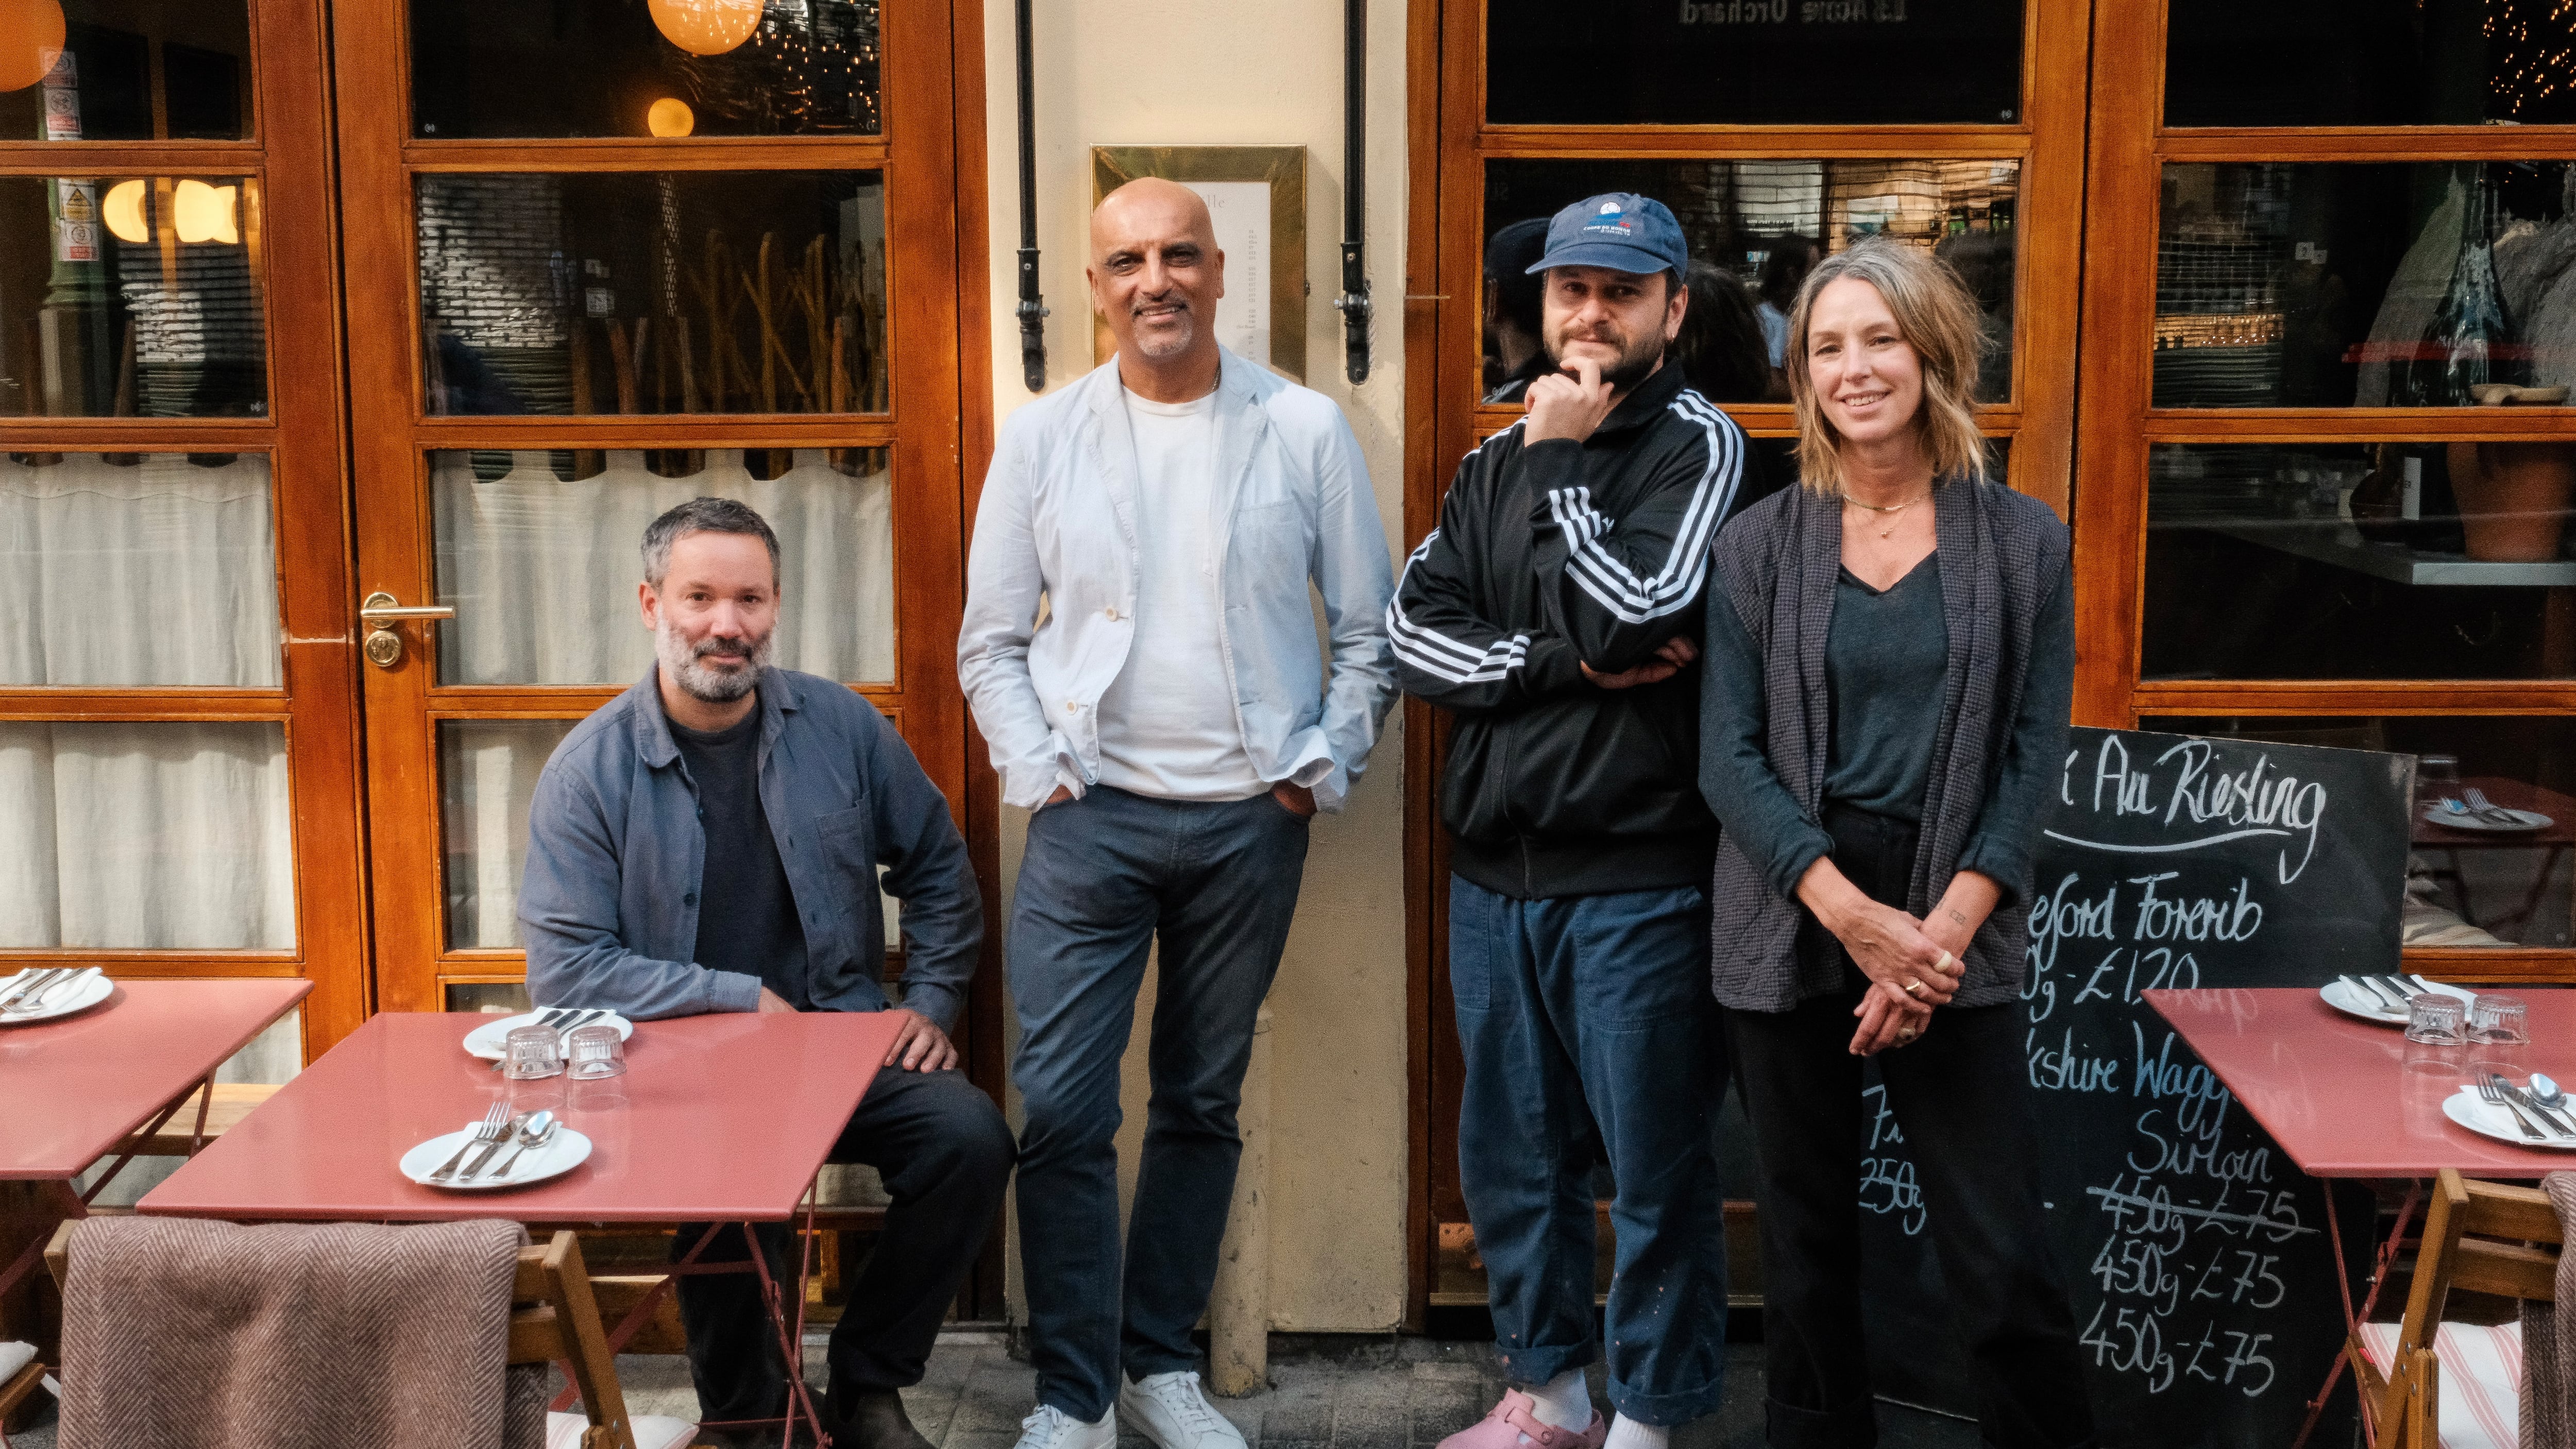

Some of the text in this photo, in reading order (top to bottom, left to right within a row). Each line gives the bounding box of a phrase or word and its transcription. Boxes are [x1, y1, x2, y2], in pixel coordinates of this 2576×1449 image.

[2095, 735, 2157, 816] Au
[2154, 739, 2327, 885] Riesling
[2028, 871, 2264, 972] eford Forerib
[2132, 1020, 2231, 1141] Wagy
[2127, 1109, 2273, 1185] Sirloin
